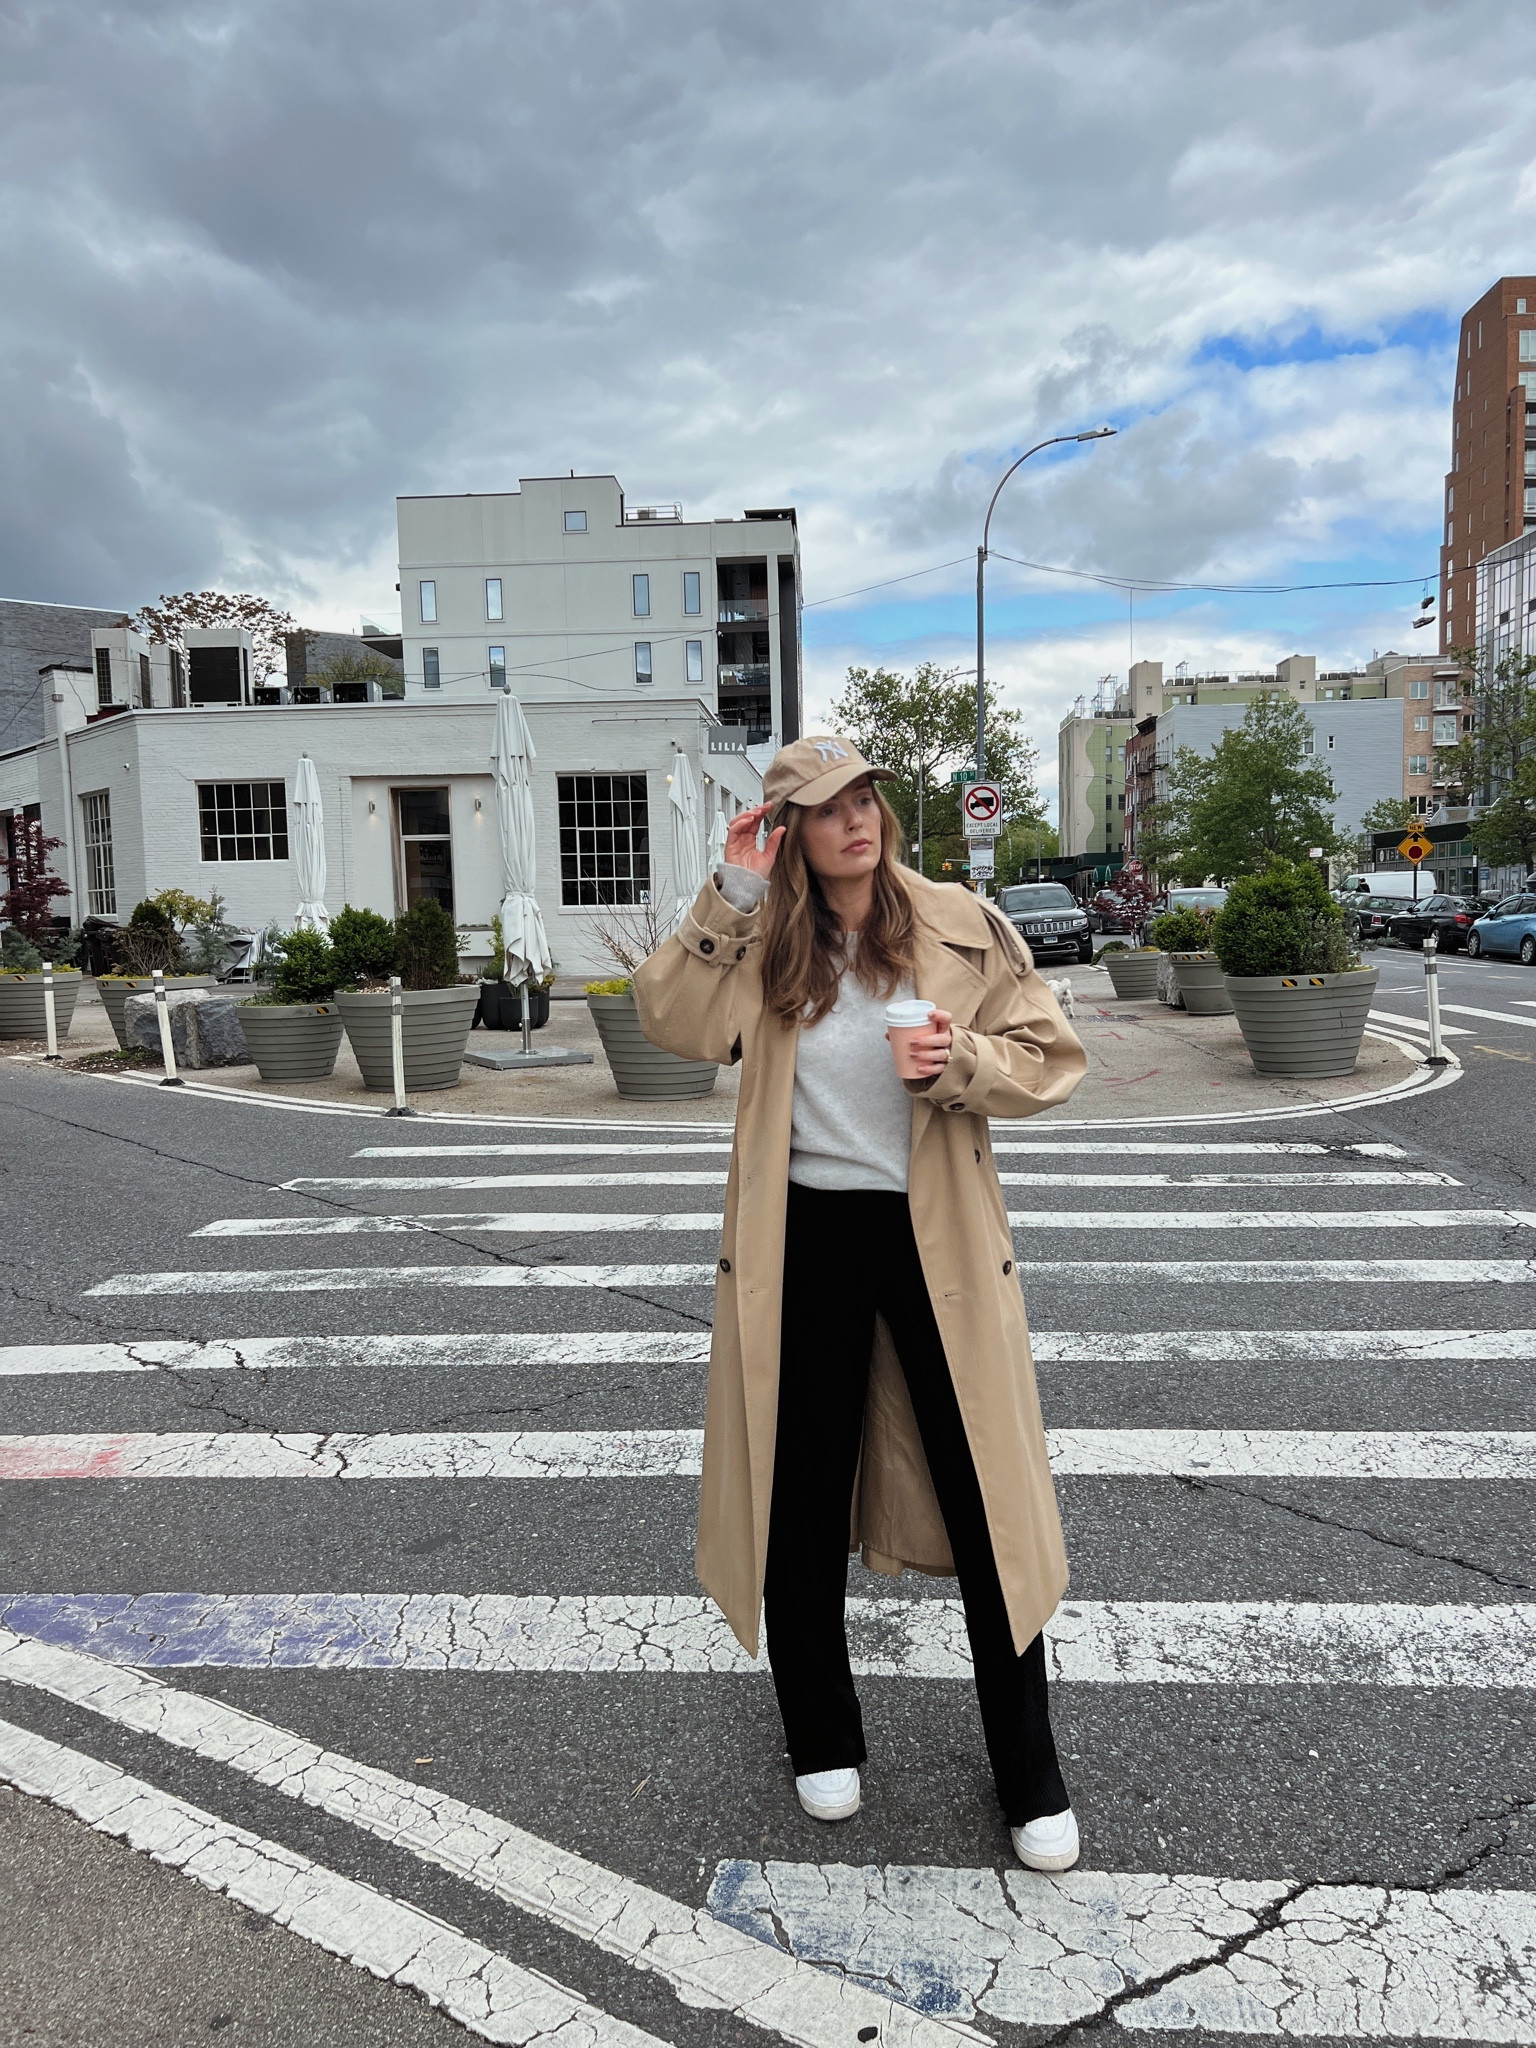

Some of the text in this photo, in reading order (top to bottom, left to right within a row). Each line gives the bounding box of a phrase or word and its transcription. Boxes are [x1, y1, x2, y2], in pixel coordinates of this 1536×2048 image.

[711, 742, 745, 751] LILIA
[814, 740, 848, 763] NY
[952, 773, 957, 782] N
[960, 772, 967, 781] 10
[642, 891, 649, 901] A
